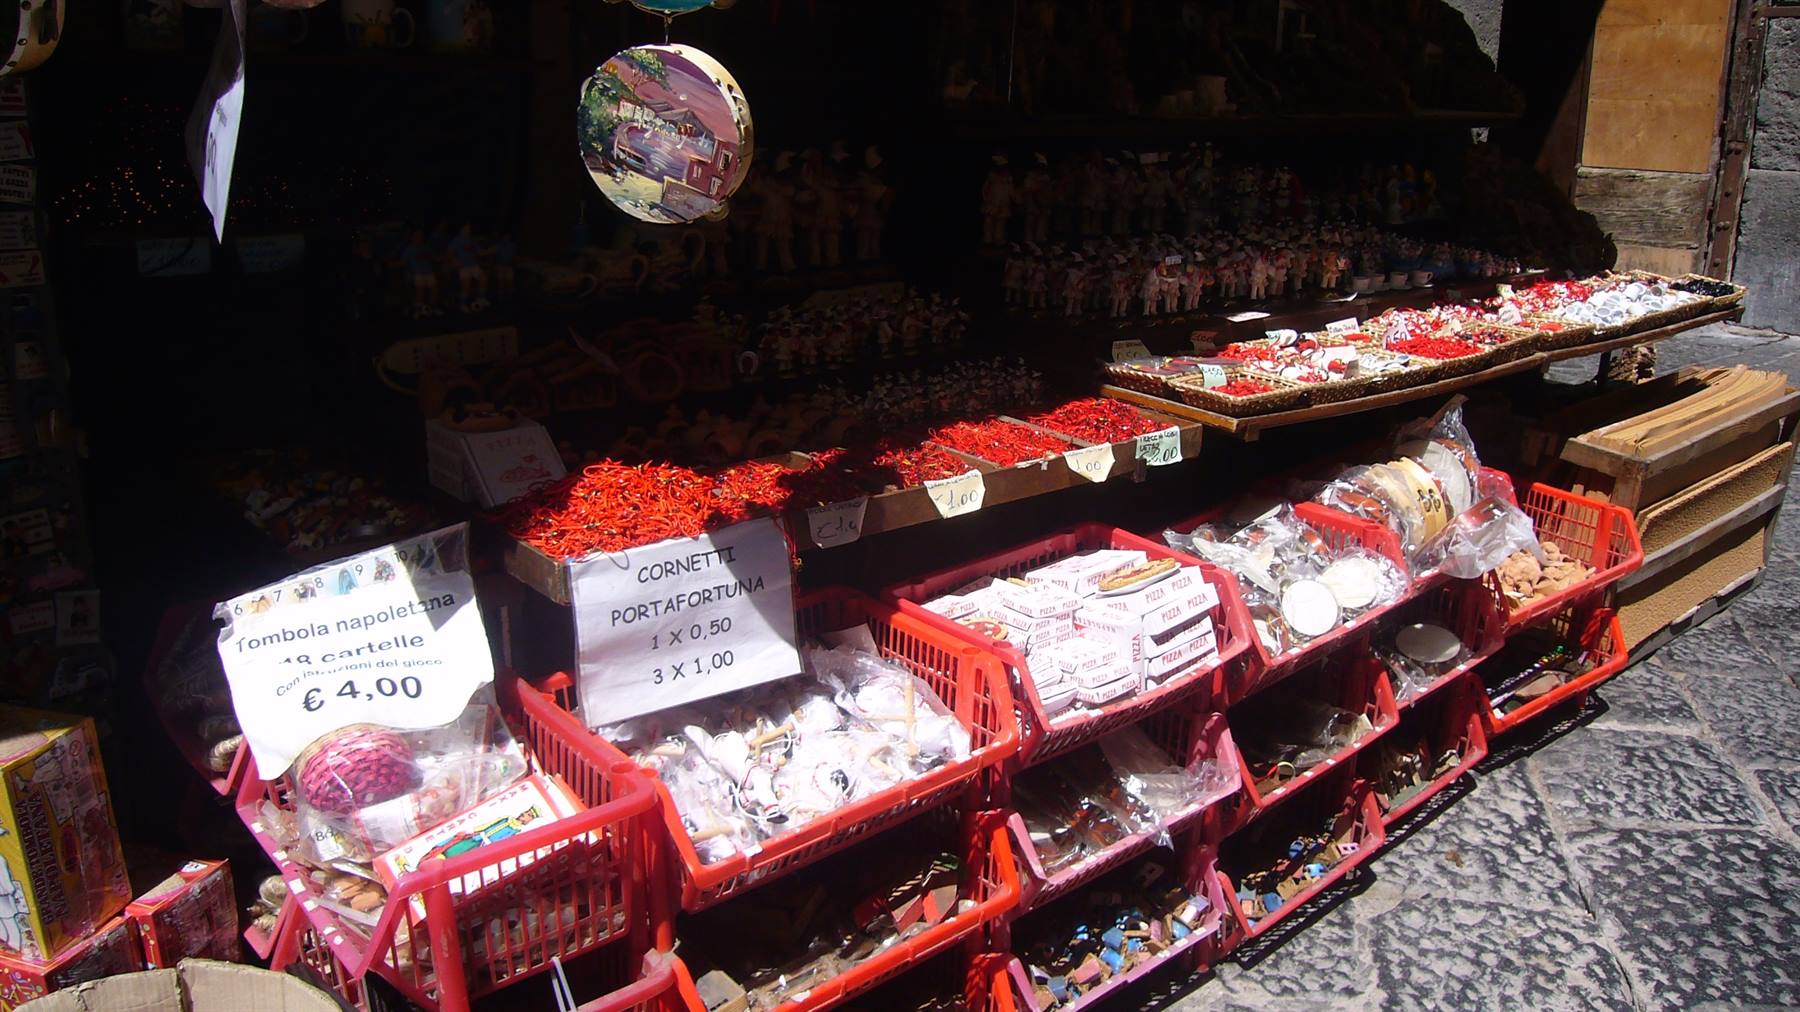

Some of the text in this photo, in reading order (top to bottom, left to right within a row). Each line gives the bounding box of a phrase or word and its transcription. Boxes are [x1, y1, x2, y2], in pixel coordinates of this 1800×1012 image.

[637, 546, 736, 584] CORNETTI
[1087, 572, 1106, 586] PIZZA
[234, 550, 409, 615] 6 7 8 9 10
[1145, 575, 1193, 604] PIZZA PIZZA
[611, 575, 765, 627] PORTAFORTUNA
[1040, 599, 1078, 616] PIZZA PIZZA
[1161, 592, 1209, 623] PIZZA PIZZA
[235, 593, 455, 653] Tombola napoletana
[1013, 617, 1028, 628] PIZZA
[1056, 612, 1071, 622] PIZZA
[651, 616, 732, 650] 1 X 0,50
[1131, 633, 1141, 663] PIZZA
[321, 634, 425, 663] cartelle
[1162, 649, 1183, 665] PIZZA
[1189, 636, 1209, 652] PIZZA
[276, 676, 300, 697] Con
[303, 660, 372, 679] iszioni
[376, 658, 398, 669] del
[653, 650, 734, 685] 3 X 1,00
[1082, 659, 1097, 670] PIZZA
[302, 676, 422, 712] € 4,00
[1102, 688, 1118, 700] PIZZA
[14, 797, 41, 868] TOMBOLA
